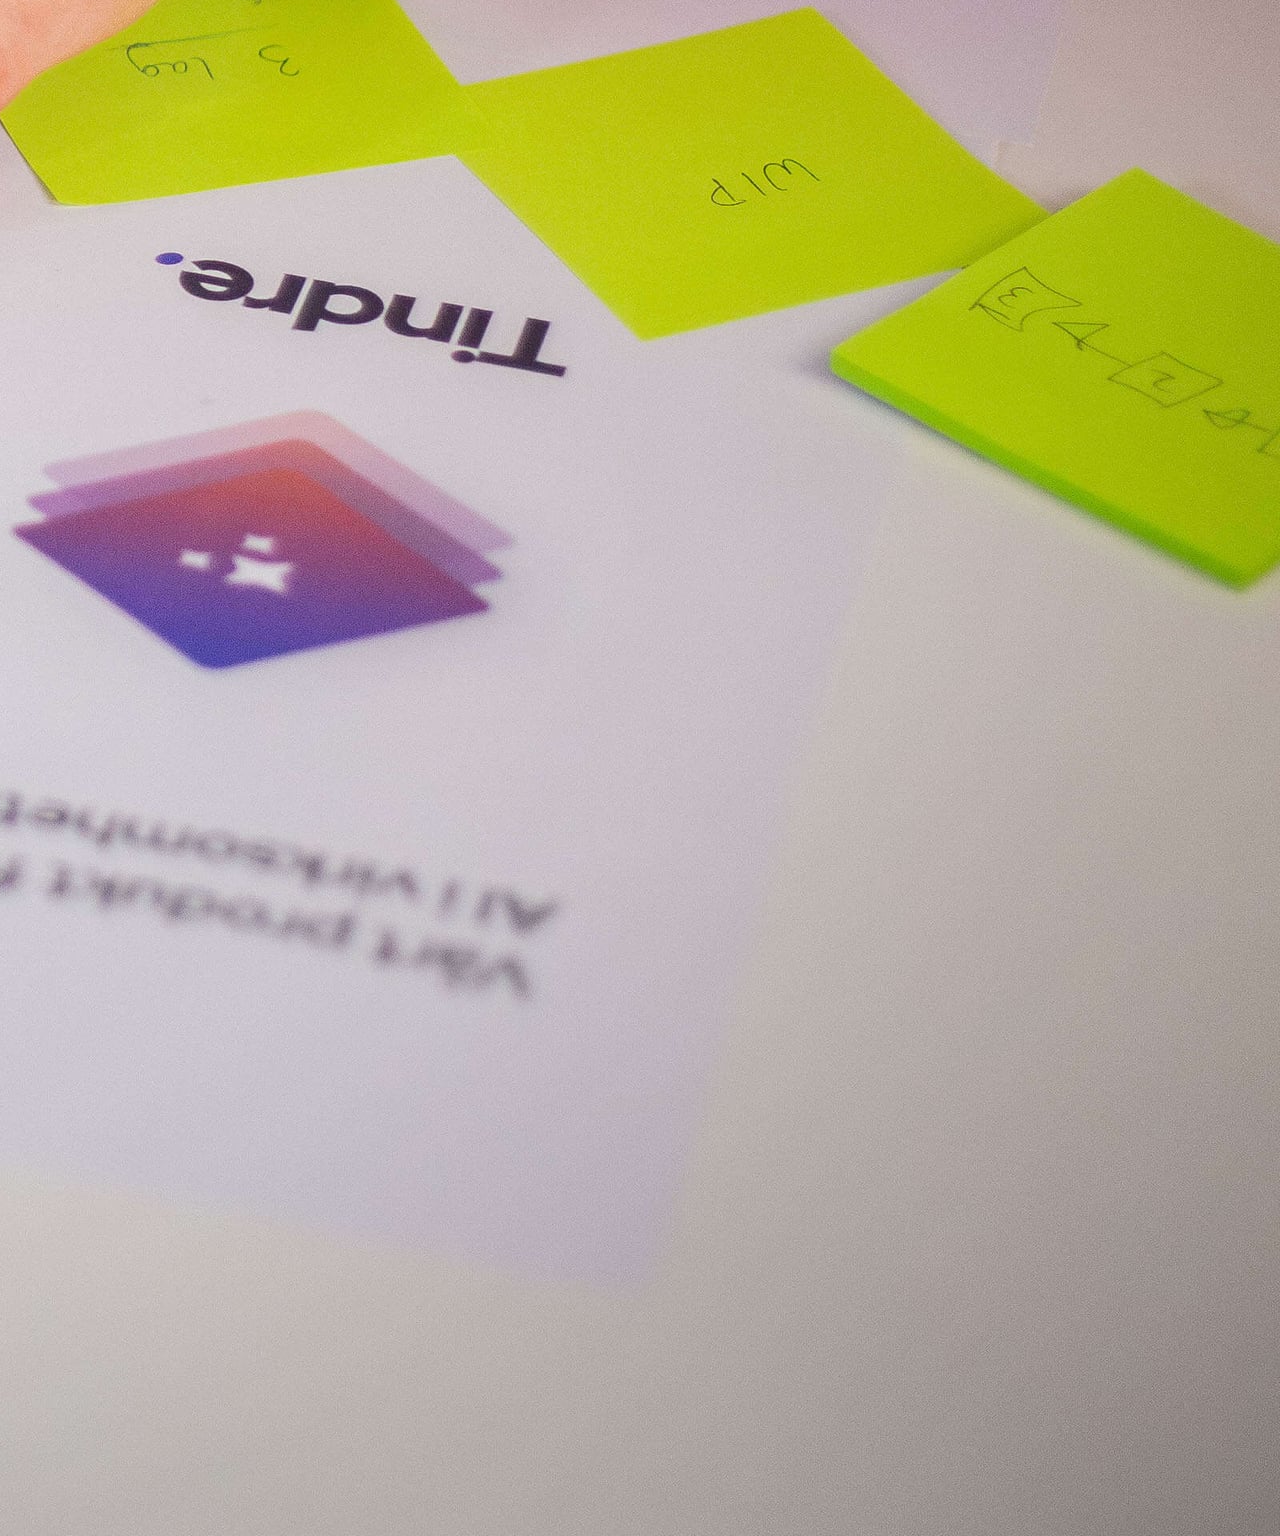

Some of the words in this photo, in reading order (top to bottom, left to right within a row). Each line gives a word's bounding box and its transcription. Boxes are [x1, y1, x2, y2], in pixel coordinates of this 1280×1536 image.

[258, 44, 300, 77] 3
[710, 158, 821, 207] WIP
[46, 862, 357, 951] produkt
[440, 876, 460, 917] i
[473, 886, 561, 935] AI
[372, 927, 534, 1002] Vårt
